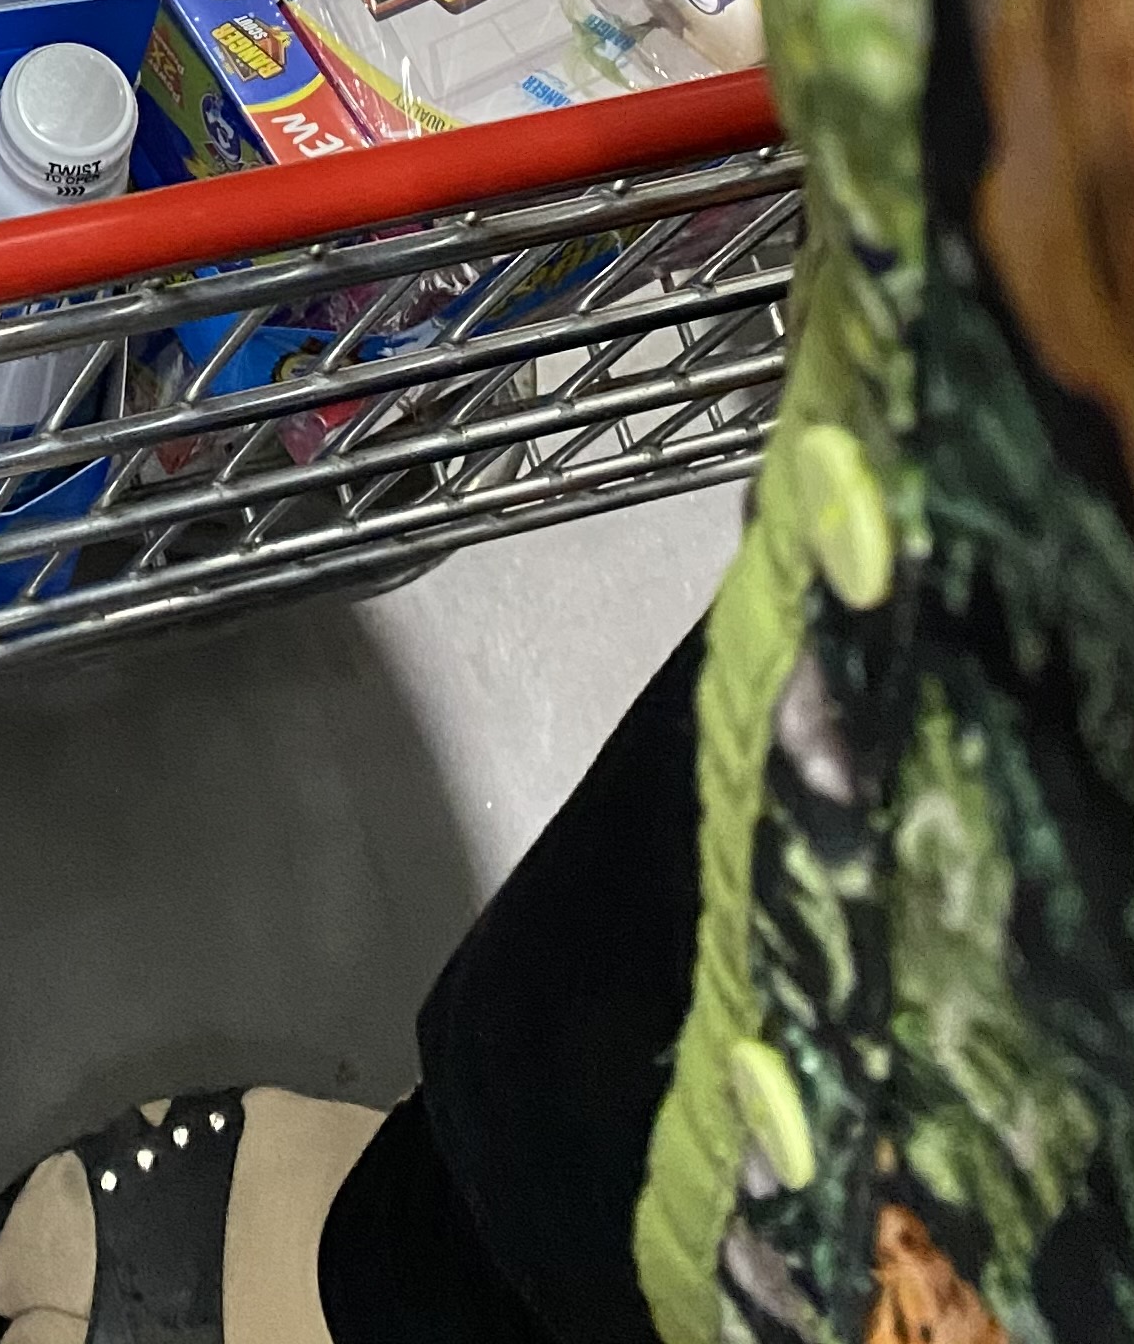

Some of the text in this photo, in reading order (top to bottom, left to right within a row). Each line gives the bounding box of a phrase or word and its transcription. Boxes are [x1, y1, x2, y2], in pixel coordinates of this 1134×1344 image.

[232, 15, 268, 41] SCOUT
[211, 21, 284, 79] RANGER
[270, 112, 355, 159] EW
[44, 172, 101, 185] TO OPEN
[48, 160, 102, 177] TWIST
